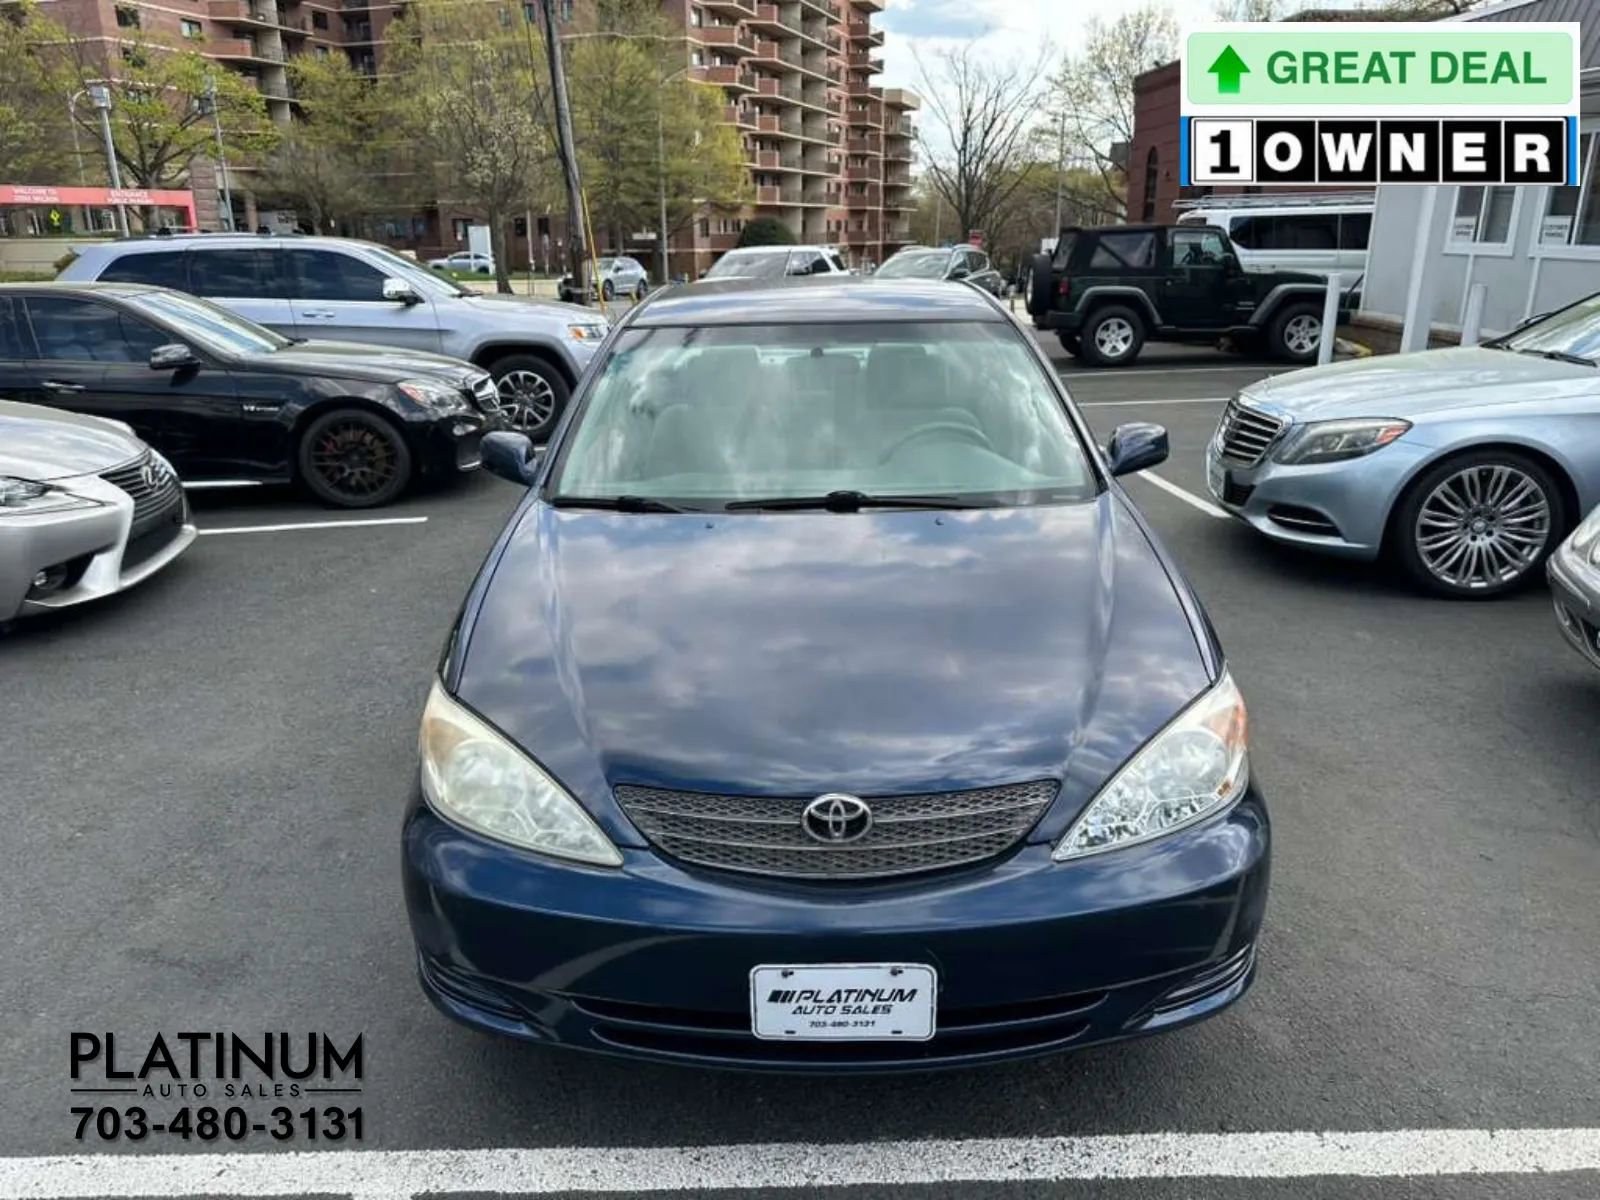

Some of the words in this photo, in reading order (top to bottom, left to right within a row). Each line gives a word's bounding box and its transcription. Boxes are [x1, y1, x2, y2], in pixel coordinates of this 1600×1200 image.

[796, 988, 918, 1004] PLATINUM
[792, 1005, 836, 1015] AUTO
[840, 1004, 894, 1015] SALES
[809, 1019, 876, 1028] 703-480-3131
